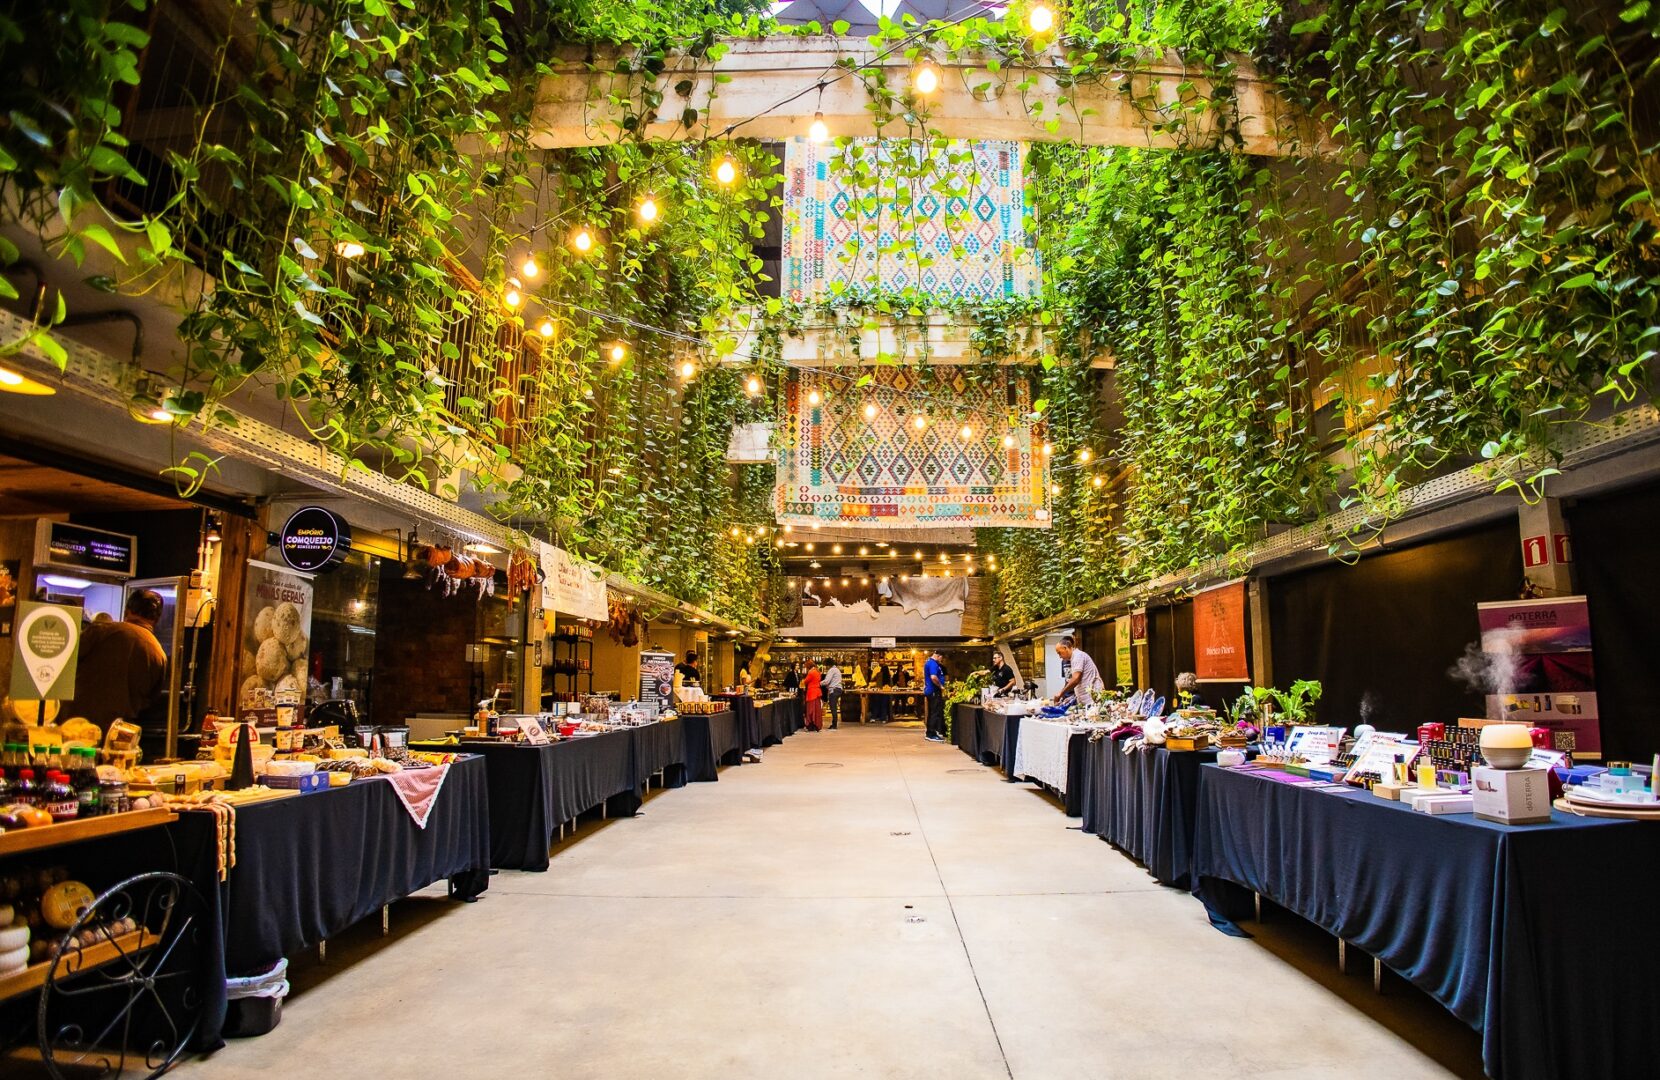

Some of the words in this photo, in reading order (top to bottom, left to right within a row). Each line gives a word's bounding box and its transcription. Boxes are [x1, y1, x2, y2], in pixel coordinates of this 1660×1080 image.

[286, 536, 333, 545] COMQUEIJO
[51, 541, 86, 552] COMQUEIJO
[256, 583, 280, 600] MINAS
[281, 590, 305, 604] GERAIS
